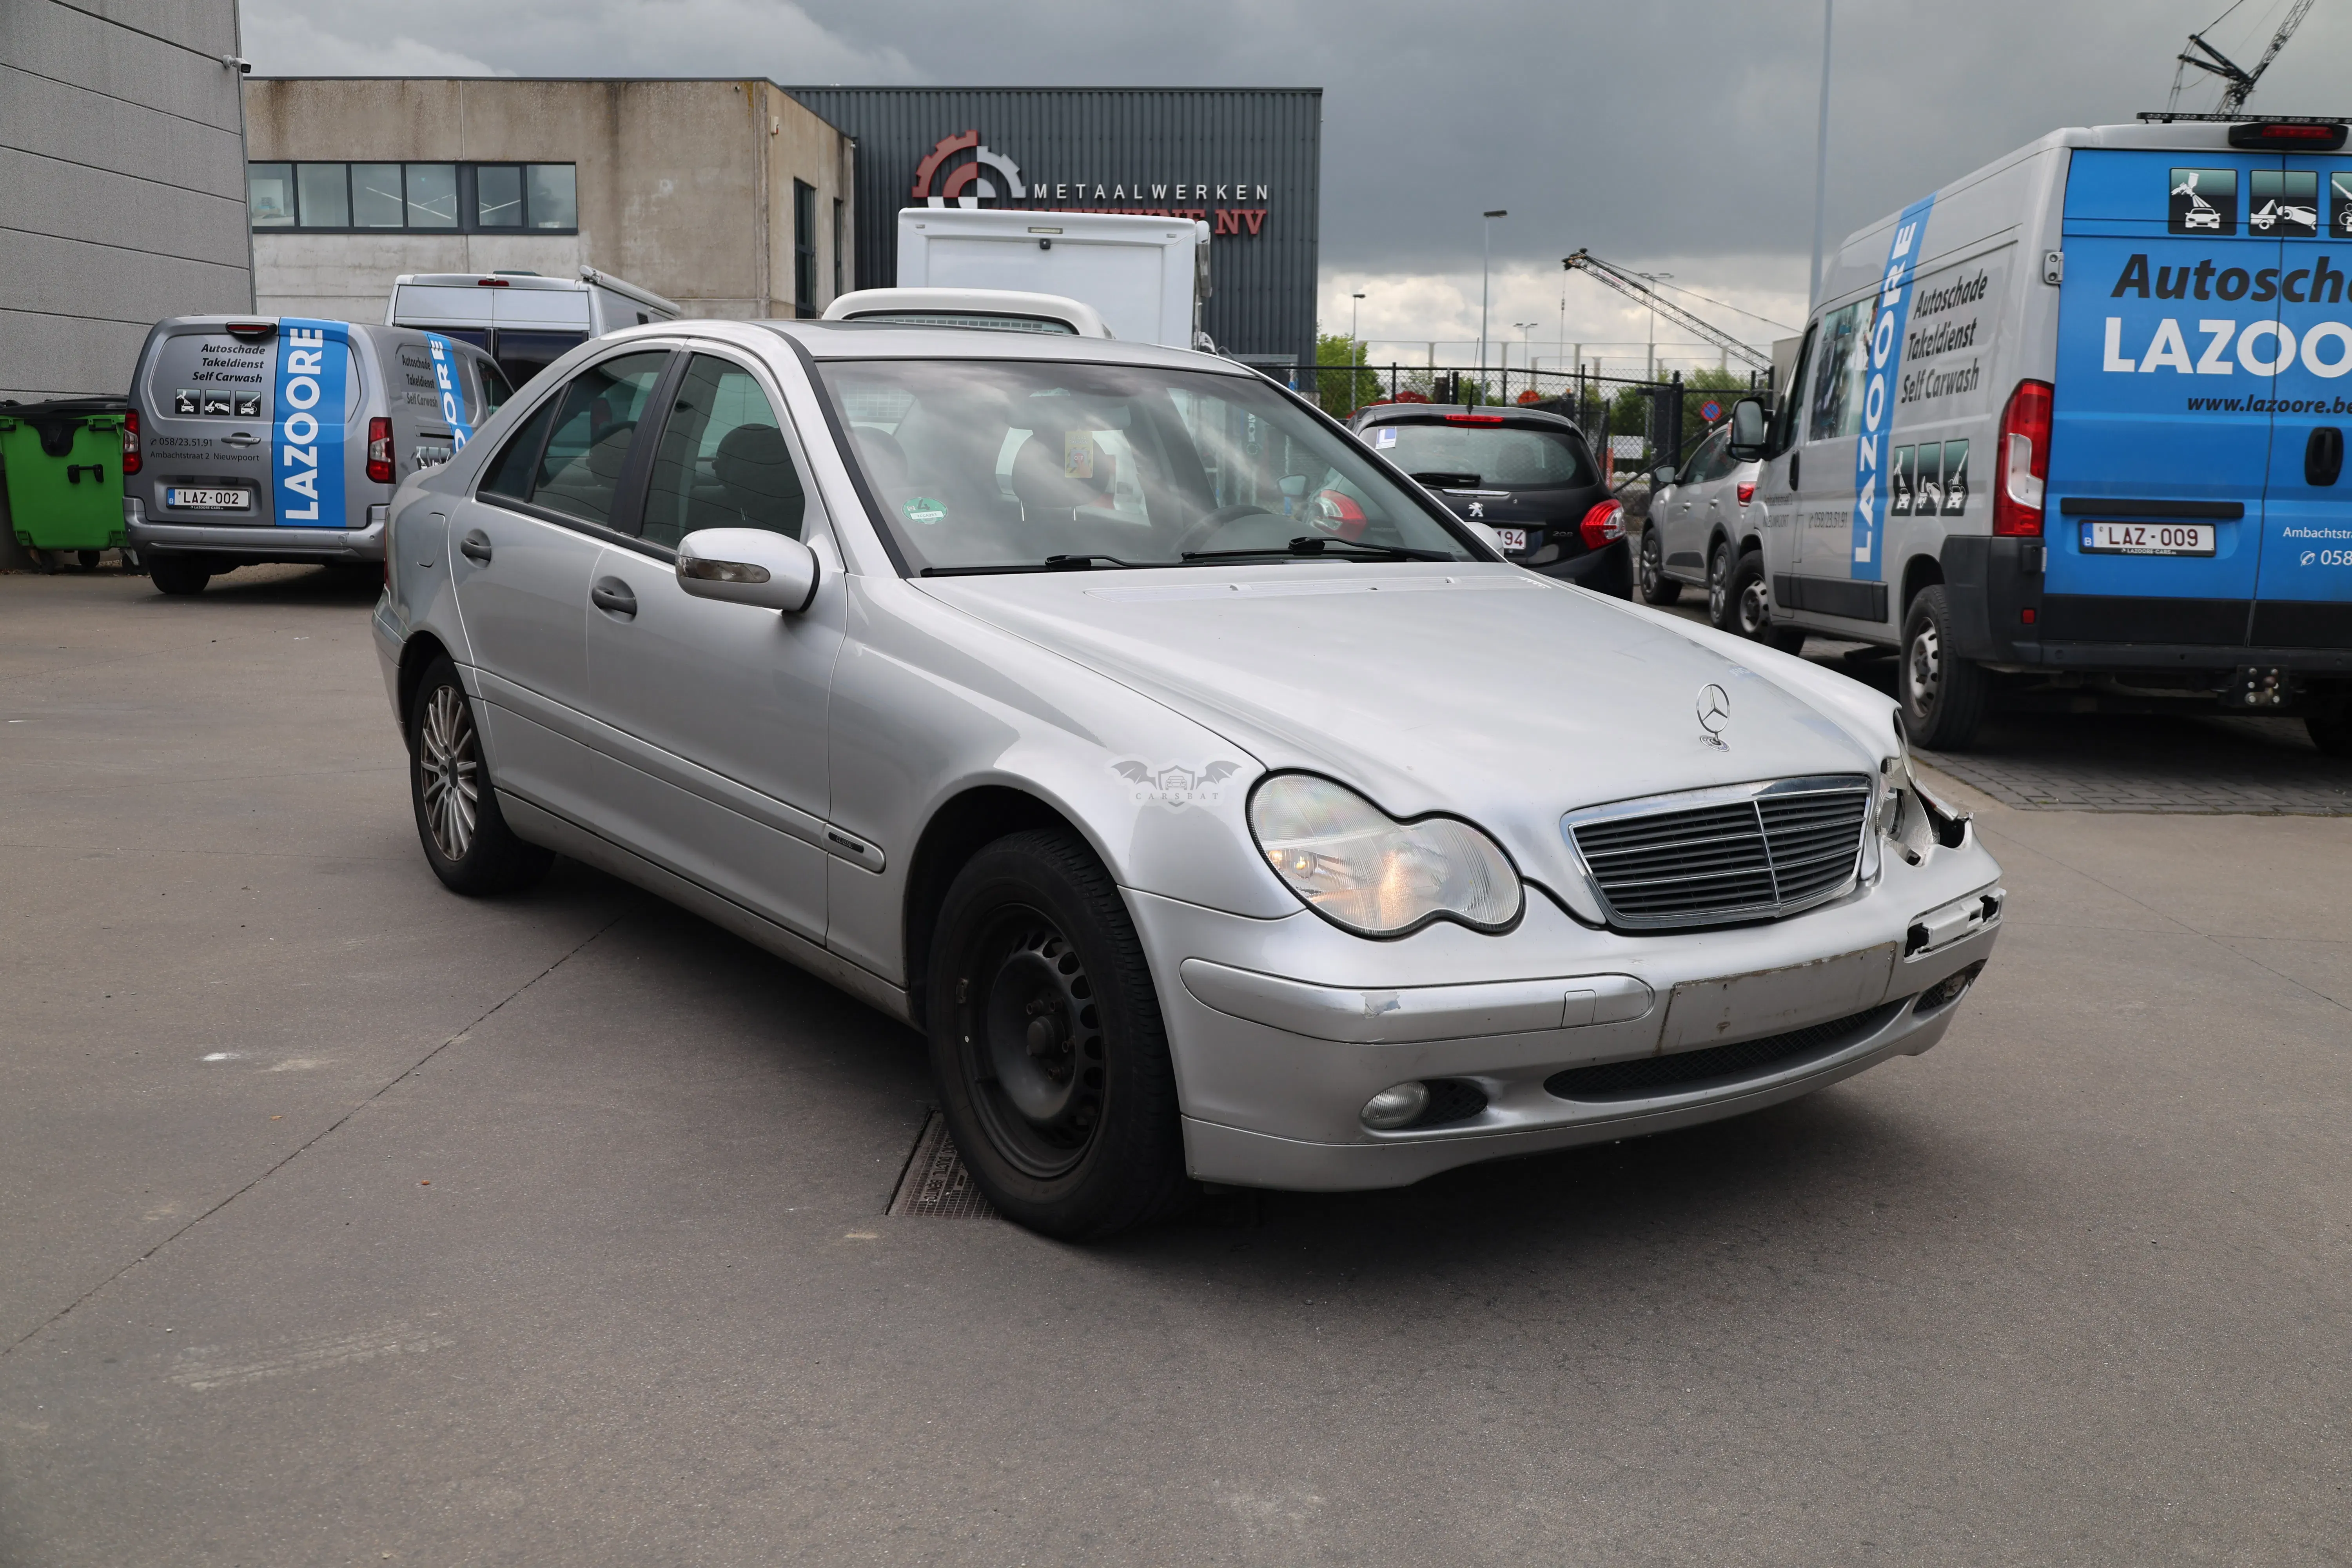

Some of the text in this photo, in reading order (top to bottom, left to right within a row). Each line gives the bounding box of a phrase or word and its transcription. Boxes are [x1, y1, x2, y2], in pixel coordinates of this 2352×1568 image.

[1034, 183, 1268, 199] METAALWERKEN
[1215, 209, 1267, 234] NV
[2110, 254, 2352, 303] Autosch
[1913, 268, 1988, 319] Autoschade
[1906, 318, 1977, 361] Takeldienst
[2103, 317, 2352, 378] LAZOO
[201, 344, 266, 355] Autoschade
[202, 358, 265, 369] Takeldienst
[402, 354, 431, 370] Autoschade
[192, 371, 263, 383] Self Carwash
[406, 374, 435, 389] Takeldienst
[1901, 358, 1980, 403] Self Carwash
[430, 340, 466, 454] OORE
[1855, 221, 1917, 562] LAZOORE
[407, 392, 438, 408] Self Carwash
[284, 328, 323, 521] LAZOORE
[159, 437, 212, 446] 058/23.51.91
[1379, 429, 1396, 443] L
[150, 451, 203, 459] Ambachtstraat
[213, 453, 260, 462] Nieuwpoort
[183, 492, 239, 505] LAZ-002
[917, 499, 930, 510] 4
[2085, 526, 2198, 547] B LAZ-009
[2283, 527, 2352, 539] Ambachtstr
[2321, 550, 2352, 565] 058
[836, 836, 853, 848] CLASSIC
